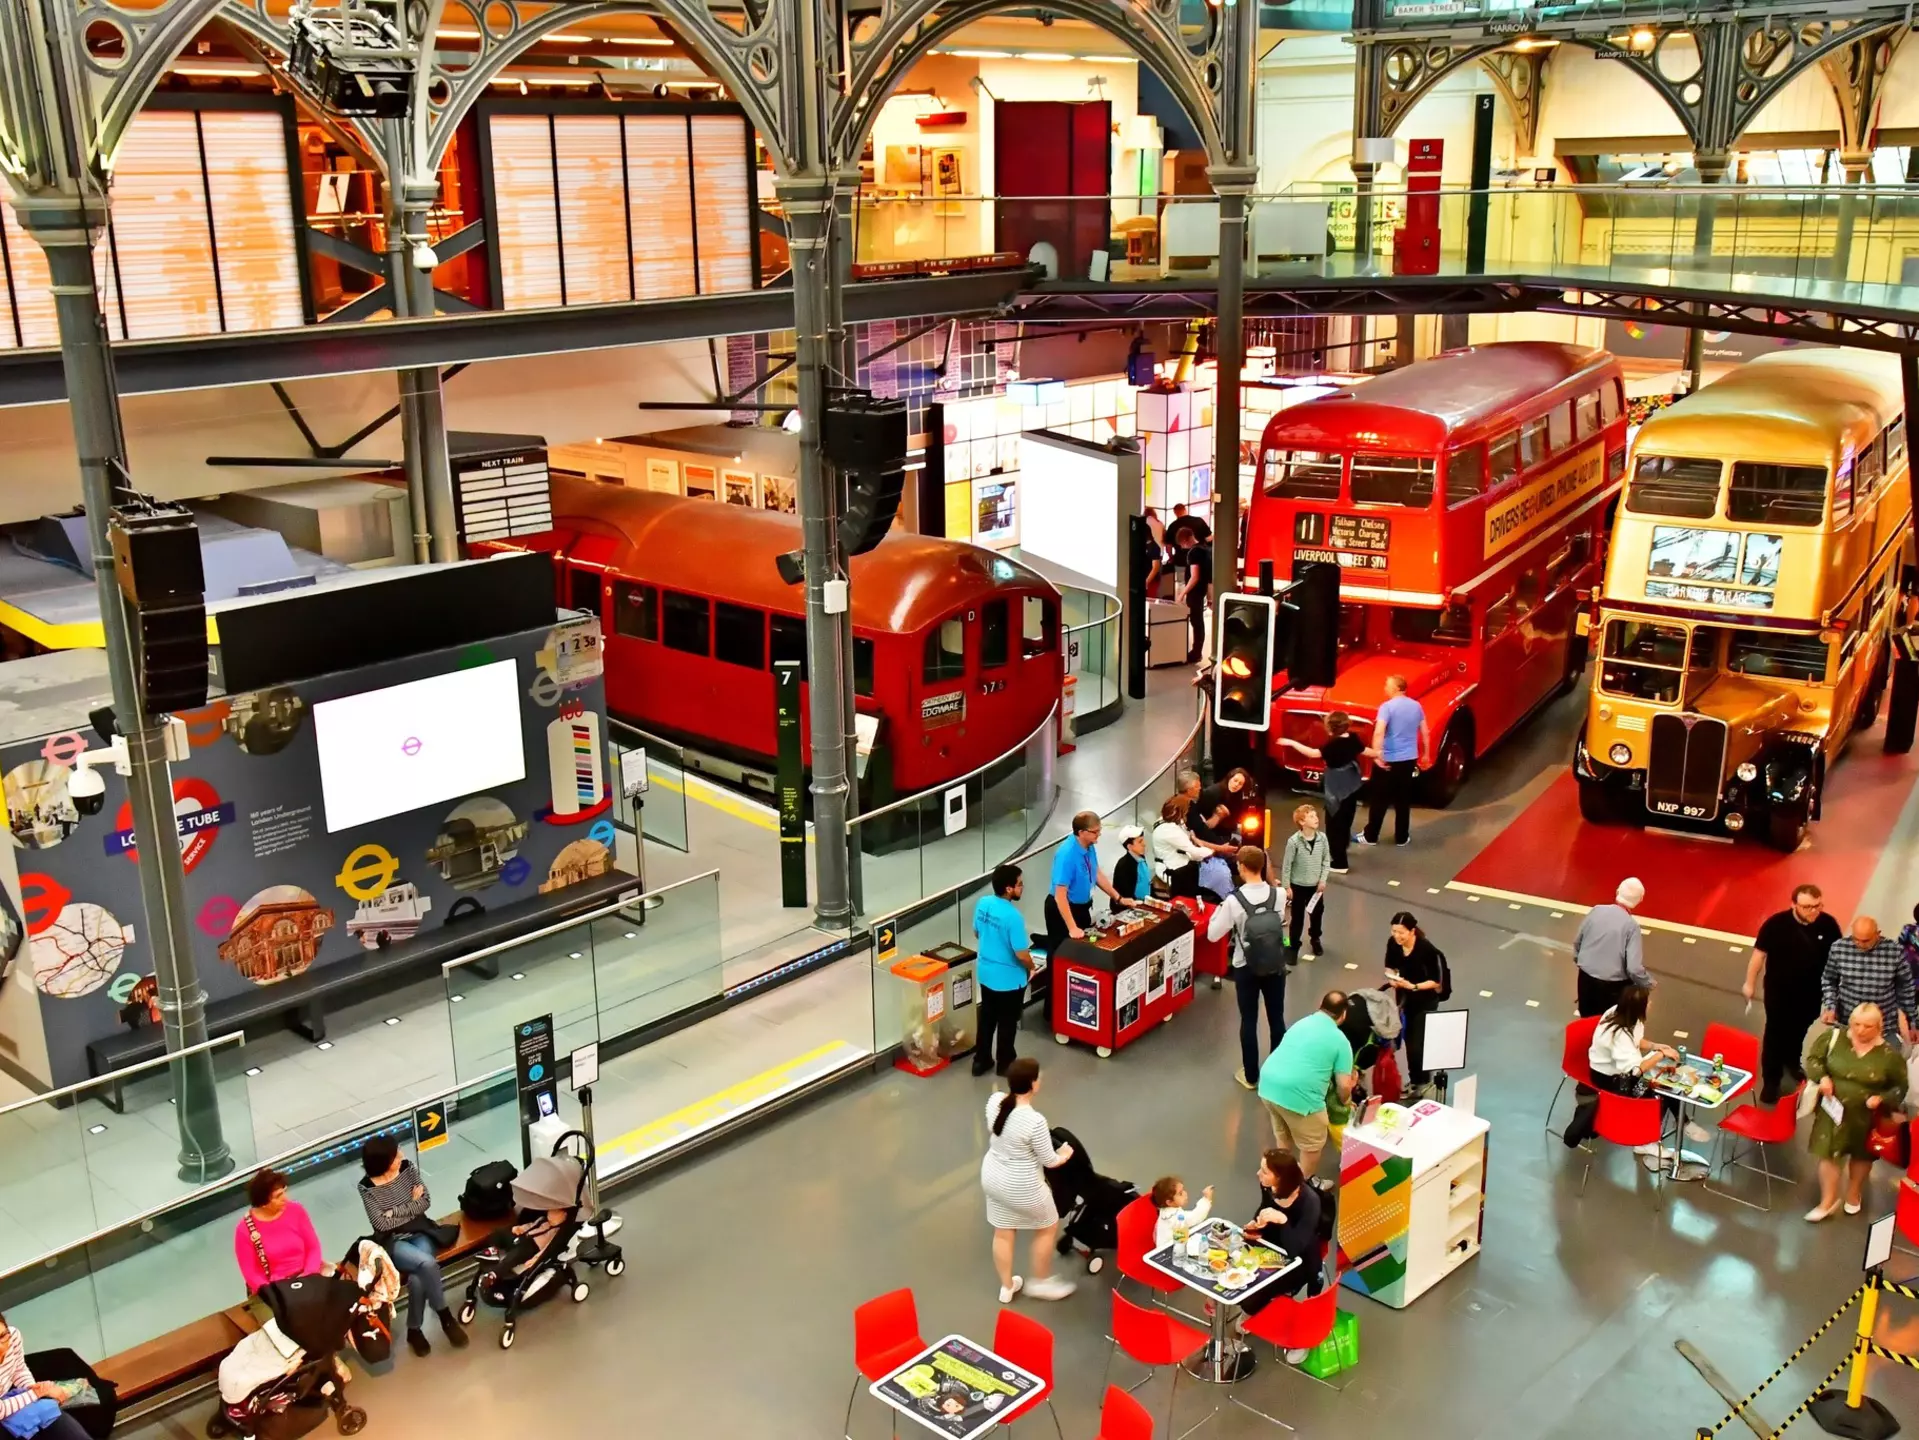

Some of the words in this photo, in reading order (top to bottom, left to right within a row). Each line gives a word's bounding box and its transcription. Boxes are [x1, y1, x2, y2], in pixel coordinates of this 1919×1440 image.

[1398, 5, 1425, 14] BAKER
[1429, 3, 1459, 12] STREET
[1489, 23, 1529, 33] HARROW
[1598, 50, 1641, 58] HAMPSTEAD
[1483, 98, 1490, 109] 5
[481, 459, 500, 468] NEXT
[503, 456, 524, 465] TRAIN
[1334, 516, 1356, 527] Fulham
[1361, 519, 1385, 530] Chelsea
[1490, 504, 1519, 543] DRIVERS
[1332, 526, 1355, 537] Victoria
[1358, 529, 1380, 540] Charing
[1348, 538, 1368, 548] Street
[1370, 539, 1386, 549] Bank
[1293, 549, 1336, 563] LIVERPOOL
[1370, 555, 1387, 569] STN
[1712, 588, 1749, 605] GARAGE
[968, 611, 975, 621] D
[560, 641, 566, 653] 1
[574, 638, 580, 650] 2
[583, 635, 596, 648] 3a
[781, 671, 791, 685] 7
[922, 701, 959, 718] EDGWARE
[1306, 770, 1323, 780] 73
[250, 816, 273, 826] London
[274, 805, 311, 820] Underground
[1657, 801, 1679, 813] NXP
[1683, 806, 1706, 817] 997
[186, 811, 220, 829] TUBE
[183, 837, 206, 866] SERVICE
[527, 1056, 542, 1066] GIVE
